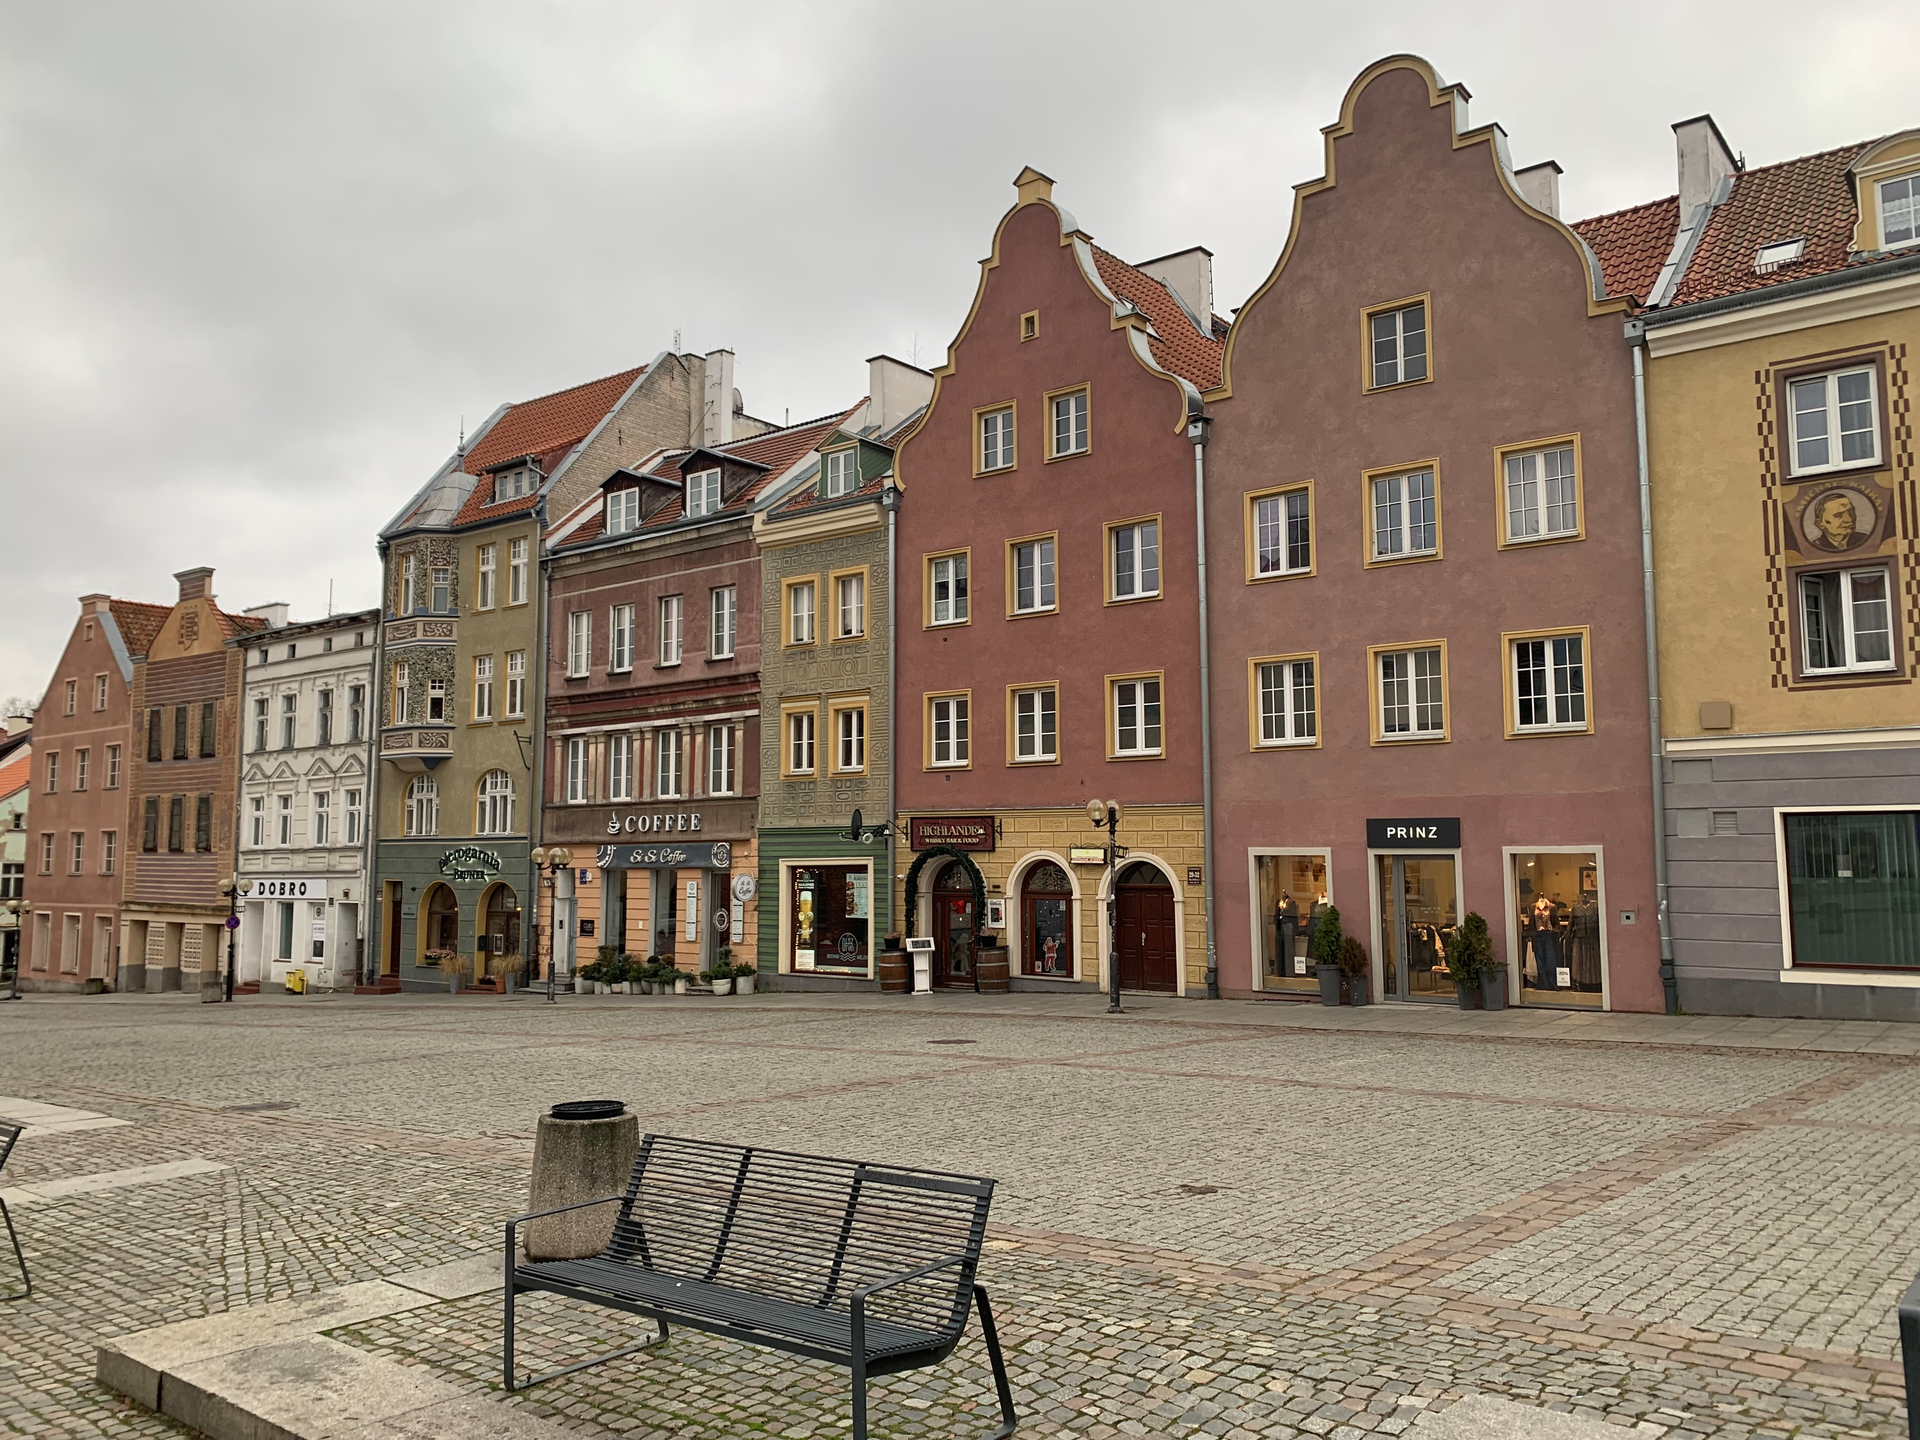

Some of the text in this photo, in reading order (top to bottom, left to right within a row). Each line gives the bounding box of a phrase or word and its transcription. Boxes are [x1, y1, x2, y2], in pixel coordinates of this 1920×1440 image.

[625, 813, 702, 833] COFFEE
[1386, 826, 1438, 839] PRINZ
[439, 846, 501, 874] Pierogarnia
[659, 848, 687, 865] Coffee
[258, 881, 307, 896] DOBRO
